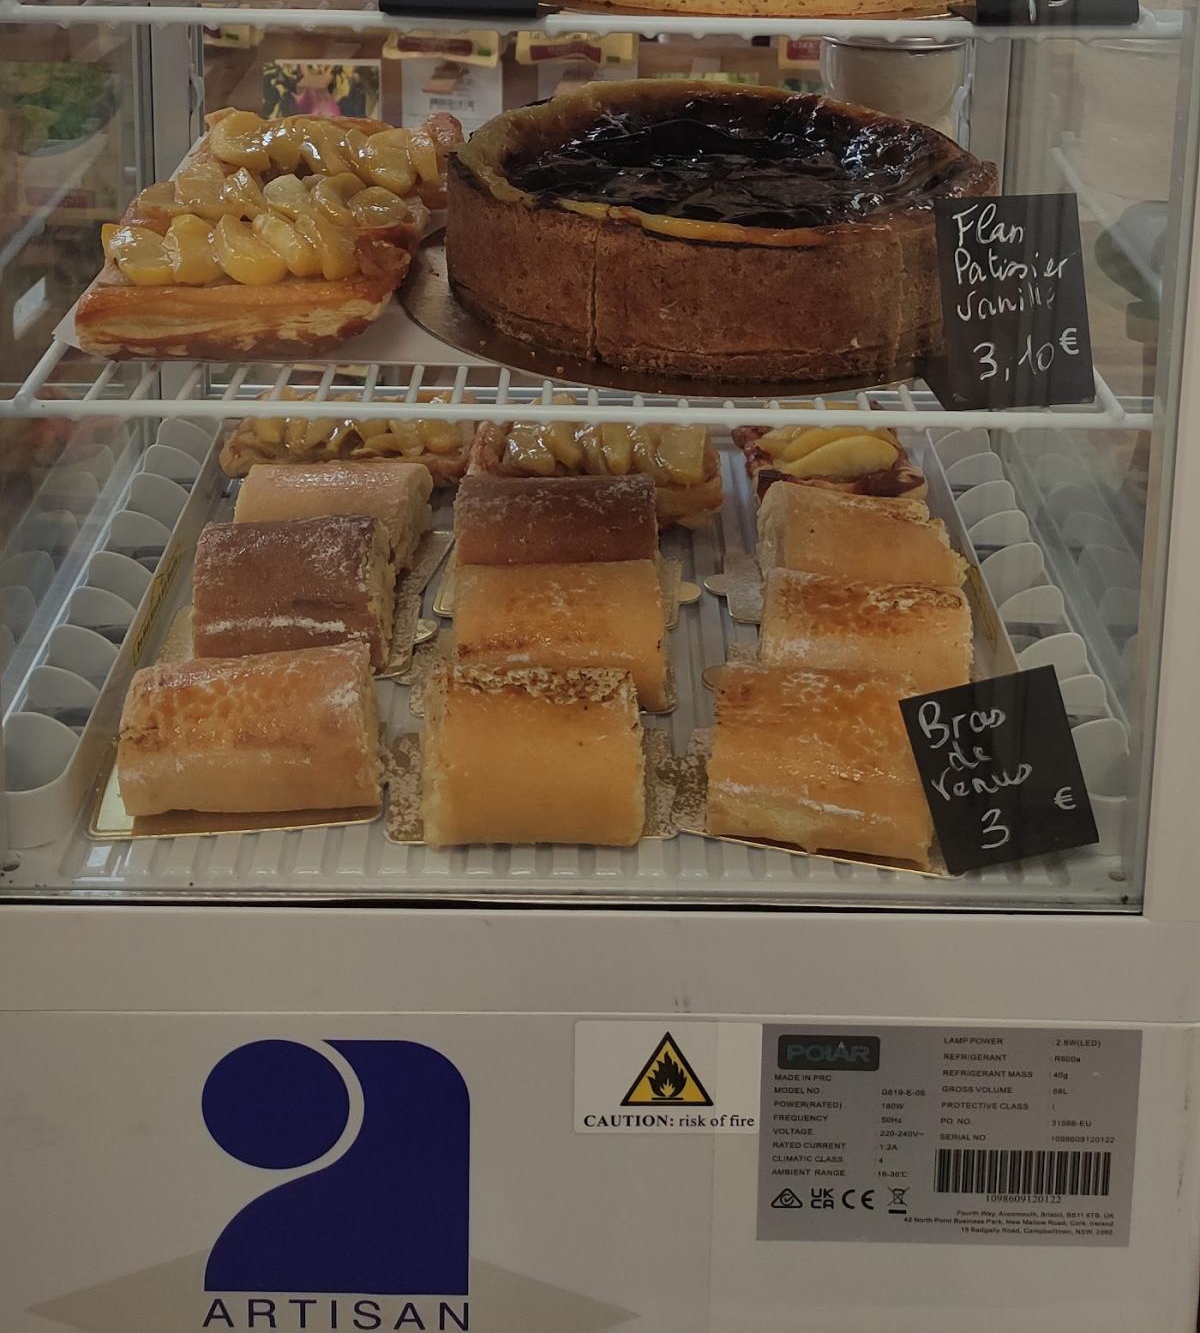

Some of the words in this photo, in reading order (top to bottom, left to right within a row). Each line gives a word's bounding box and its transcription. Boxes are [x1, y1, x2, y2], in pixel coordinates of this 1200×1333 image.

[952, 203, 1024, 247] Flan
[918, 701, 1006, 749] Bras
[948, 740, 992, 771] de
[1053, 787, 1076, 810] €
[981, 808, 1009, 849] 3
[786, 1042, 870, 1062] POLAR
[943, 1053, 1007, 1061] REFRIGERANT
[774, 1074, 800, 1082] MADE
[802, 1074, 811, 1082] IN
[813, 1074, 832, 1082] PRC
[1008, 1070, 1033, 1078] MASS
[807, 1087, 820, 1095] NO
[942, 1085, 974, 1093] GROSS
[976, 1086, 1013, 1094] VOLUME
[774, 1100, 842, 1110] POWER(RATED)
[584, 1115, 674, 1127] CAUTION:
[679, 1115, 706, 1127] risk
[710, 1115, 727, 1127] of
[730, 1115, 755, 1127] fire
[773, 1114, 828, 1122] FREQUENCY
[773, 1128, 814, 1136] VOLTAGE
[939, 1133, 970, 1141] SERIAL
[772, 1141, 801, 1149] RATED
[803, 1142, 846, 1150] CURRENT
[772, 1155, 812, 1163] CLIMATIC
[814, 1155, 843, 1163] CLASS
[814, 1169, 846, 1177] RANGE
[986, 1195, 1061, 1204] 1098609120122
[202, 1298, 469, 1331] ARTISAN
